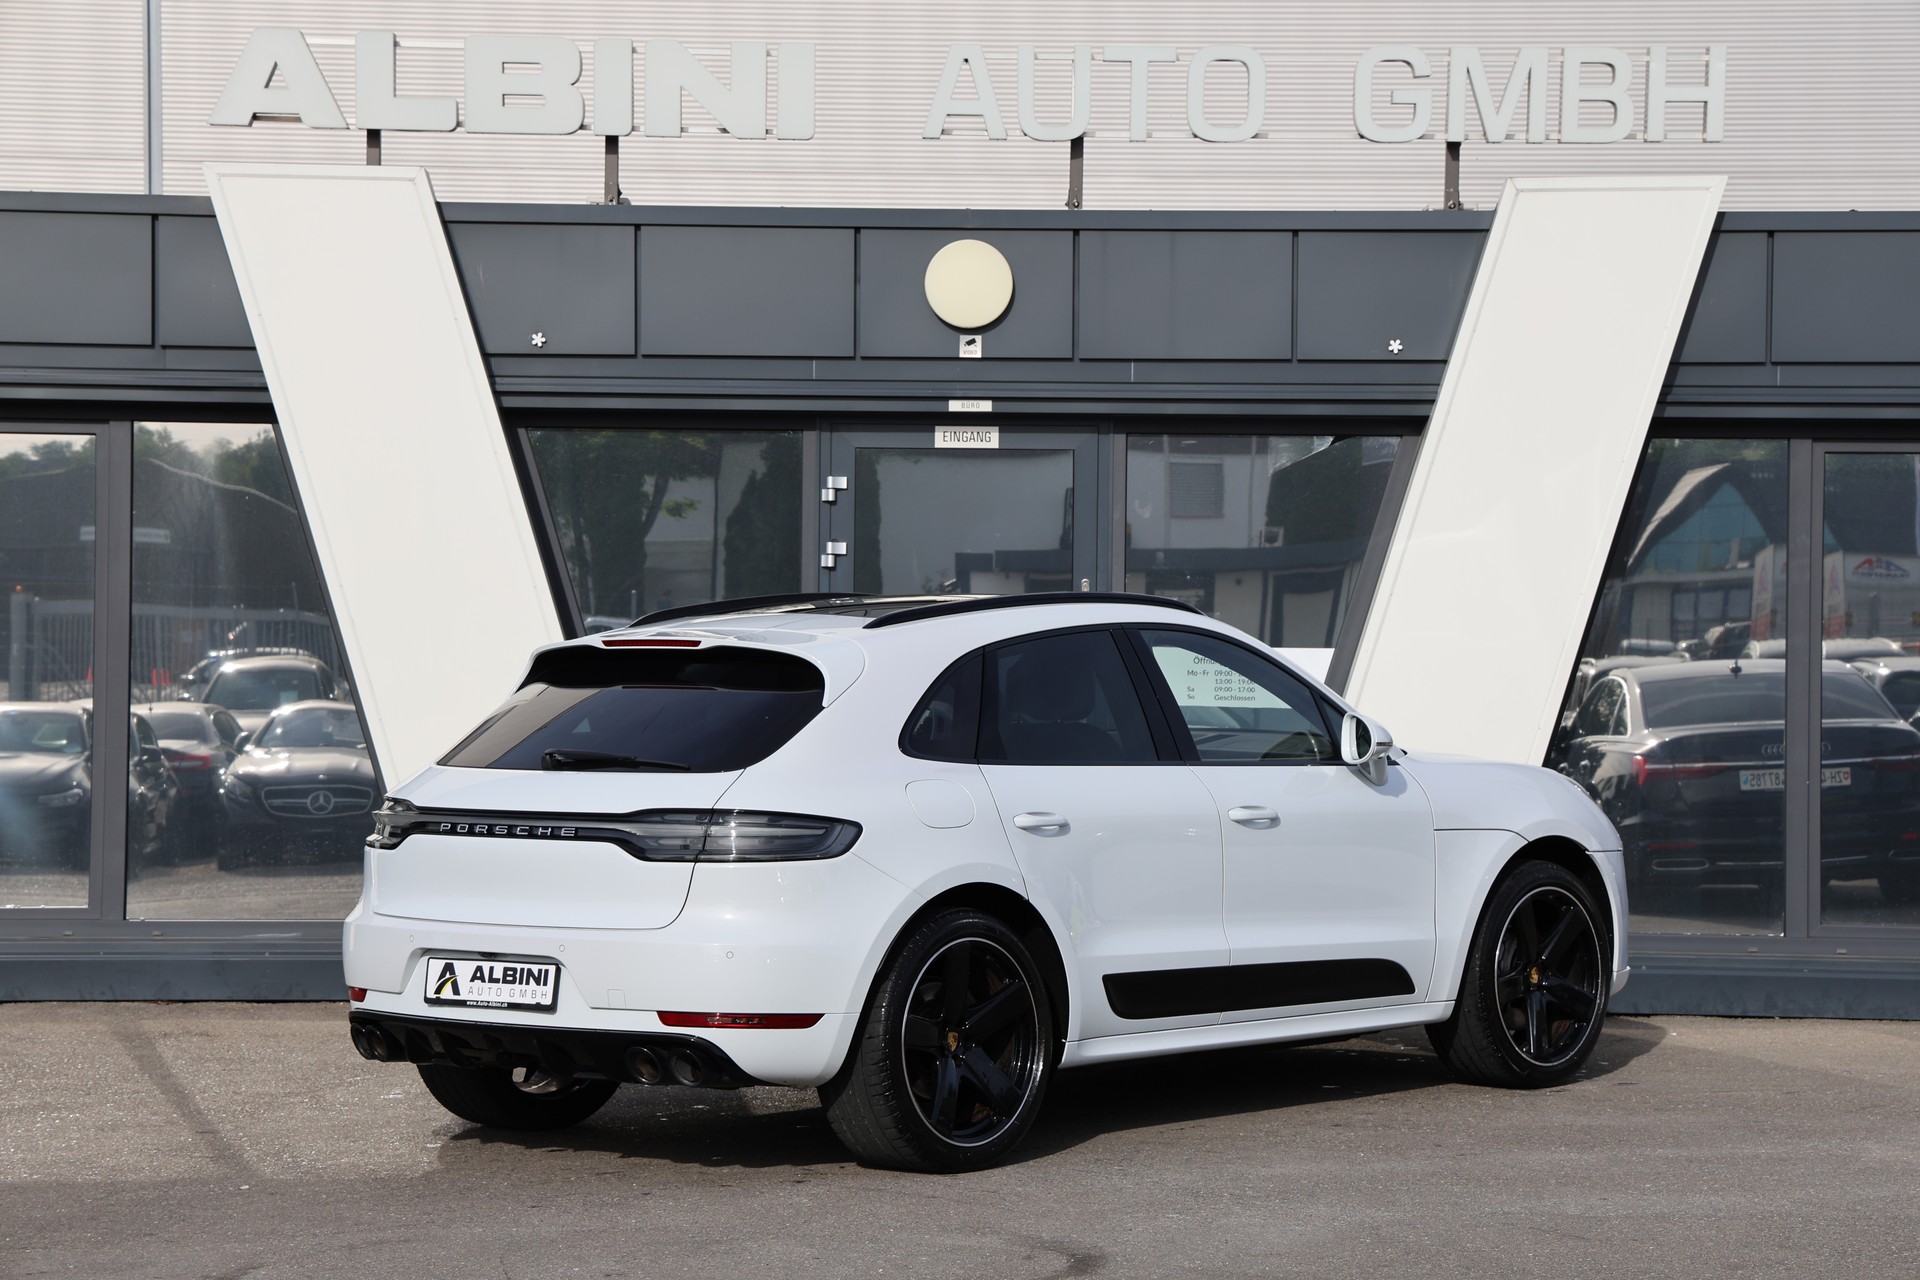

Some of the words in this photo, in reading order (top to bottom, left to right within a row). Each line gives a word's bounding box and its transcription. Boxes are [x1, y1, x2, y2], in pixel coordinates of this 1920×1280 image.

[208, 27, 816, 141] ALBINI
[922, 44, 1267, 142] AUTO
[1353, 45, 1727, 144] GMBH
[961, 401, 981, 409] BÜRO
[942, 430, 992, 443] EINGANG
[1193, 655, 1218, 664] Öffnu
[1214, 669, 1233, 677] 09:00
[440, 822, 576, 837] PORSCHE
[469, 965, 550, 987] ALBINI
[467, 986, 502, 997] AUTO
[508, 989, 548, 999] GMBH
